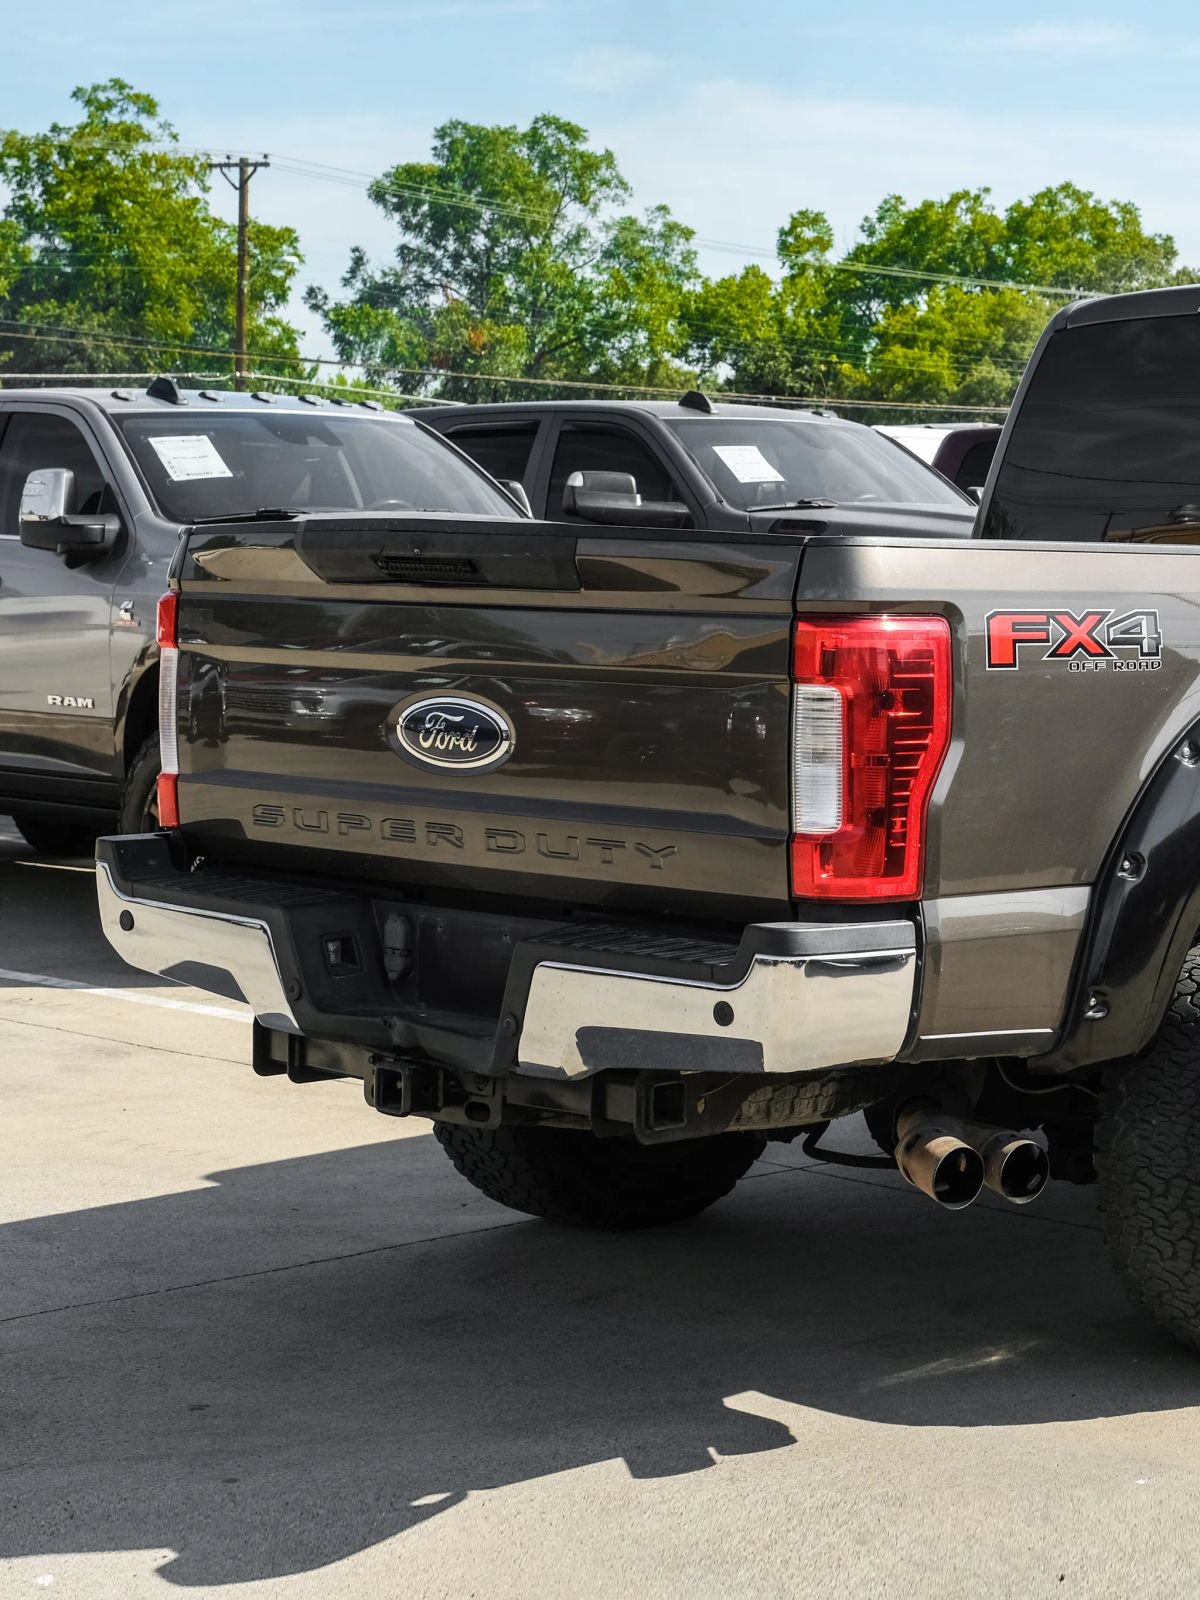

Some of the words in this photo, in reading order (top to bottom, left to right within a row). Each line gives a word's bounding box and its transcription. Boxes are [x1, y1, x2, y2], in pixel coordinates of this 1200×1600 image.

[984, 608, 1163, 671] FX4
[1067, 660, 1107, 672] OFF
[1112, 659, 1162, 671] ROAD
[47, 695, 95, 709] RAM
[418, 711, 479, 752] Ford
[252, 803, 464, 848] SUPER
[484, 827, 678, 869] DUTY
